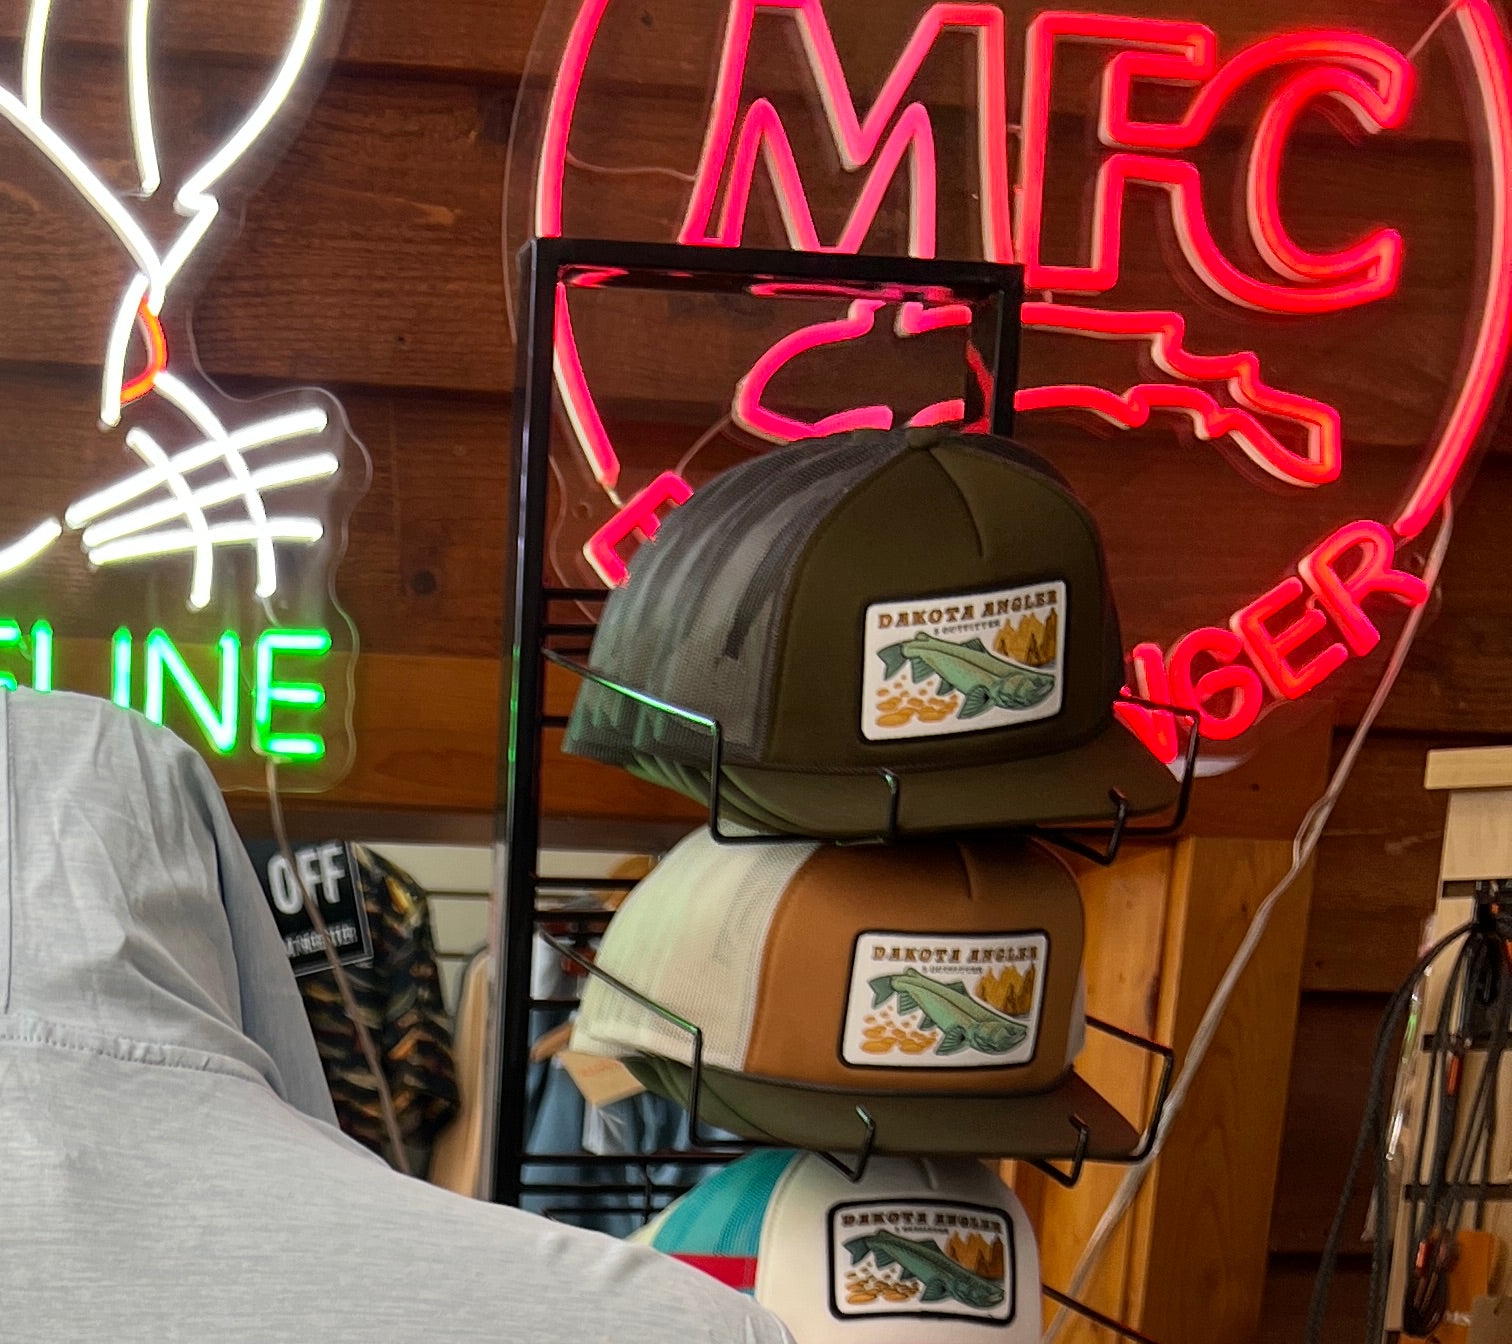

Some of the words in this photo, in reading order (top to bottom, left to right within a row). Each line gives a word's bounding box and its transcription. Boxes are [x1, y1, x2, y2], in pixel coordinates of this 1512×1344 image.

[678, 0, 1415, 313] MFC
[877, 605, 975, 629] DAKOTA
[981, 589, 1059, 616] ANGLER
[267, 842, 345, 915] OFF
[872, 945, 961, 962] DAKOTA
[967, 945, 1039, 964] ANGLER
[841, 1211, 929, 1228] DAKOTA
[934, 1212, 1004, 1234] ANGLER
